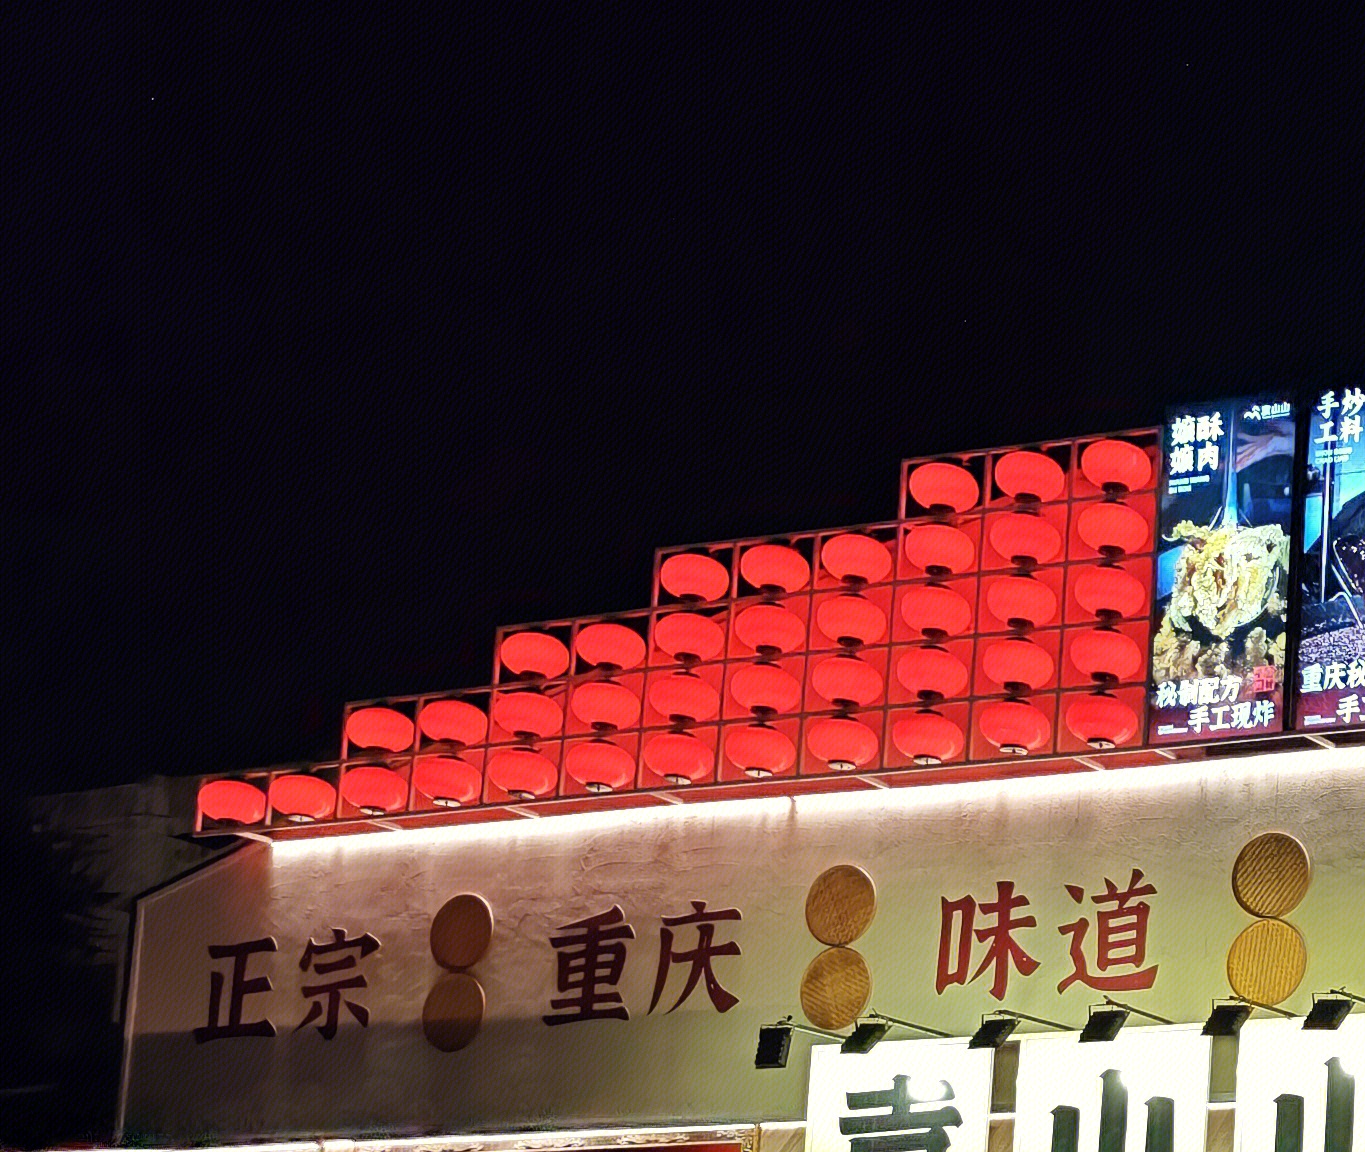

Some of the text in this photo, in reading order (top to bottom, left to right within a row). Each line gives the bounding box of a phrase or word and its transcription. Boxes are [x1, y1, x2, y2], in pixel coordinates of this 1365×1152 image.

[1188, 700, 1275, 734] 手工现炸
[194, 928, 381, 1043] 正宗
[542, 900, 743, 1027] 重庆
[935, 868, 1159, 999] 味道
